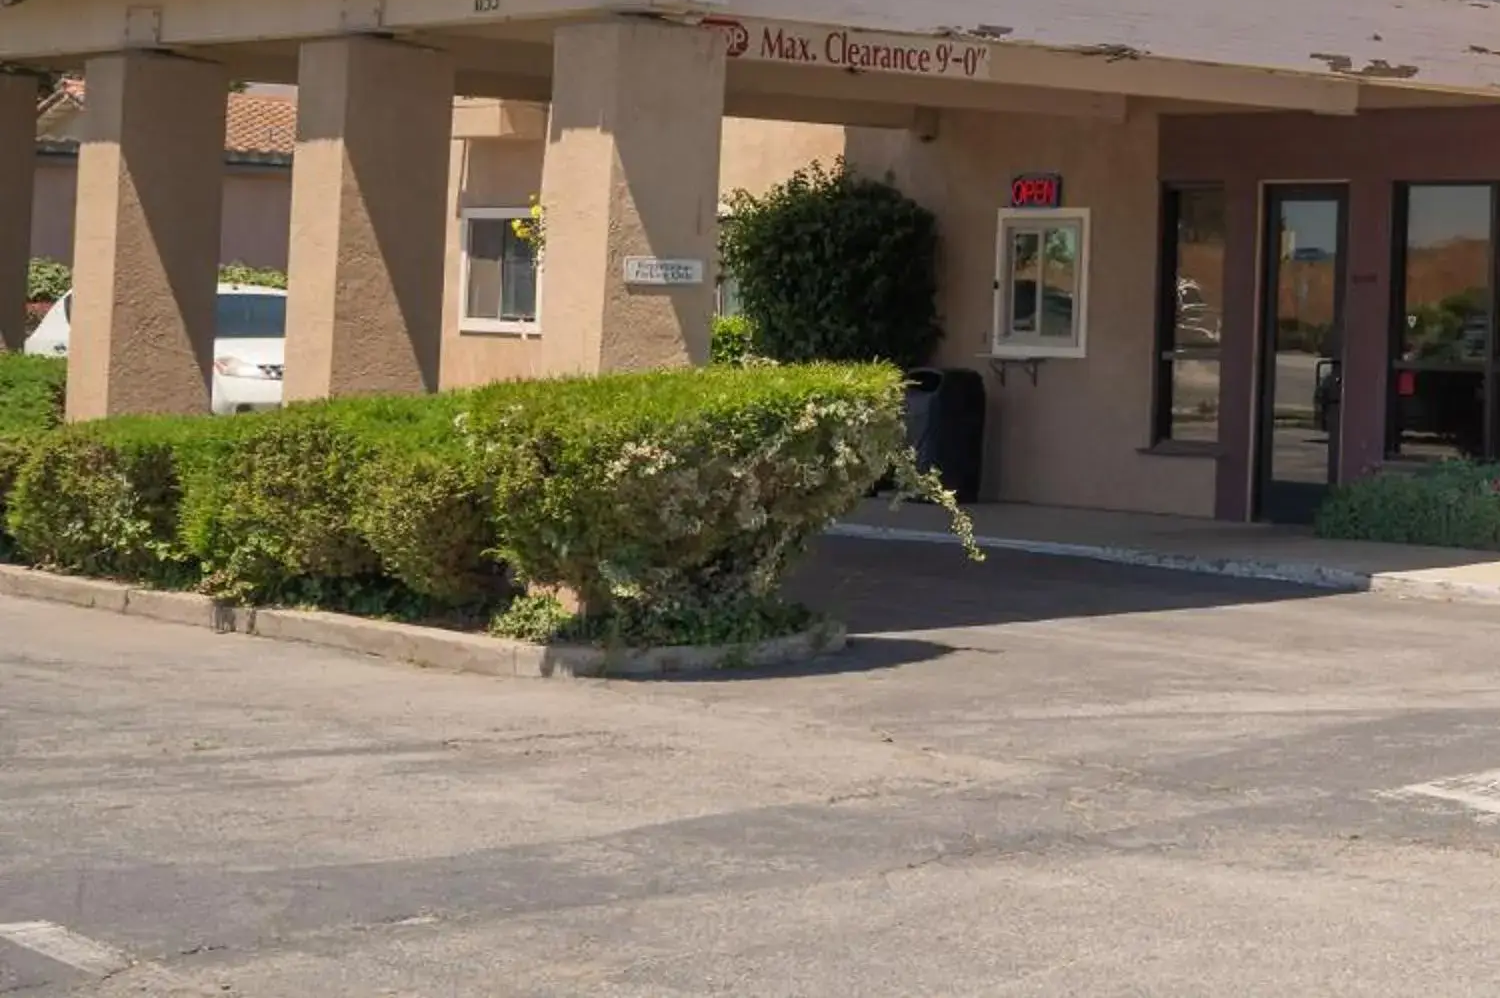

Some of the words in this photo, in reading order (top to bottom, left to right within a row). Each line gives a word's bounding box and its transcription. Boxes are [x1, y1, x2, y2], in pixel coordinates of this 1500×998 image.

[760, 26, 817, 62] Max.
[824, 30, 931, 73] Clearance
[1012, 179, 1056, 206] OPEN
